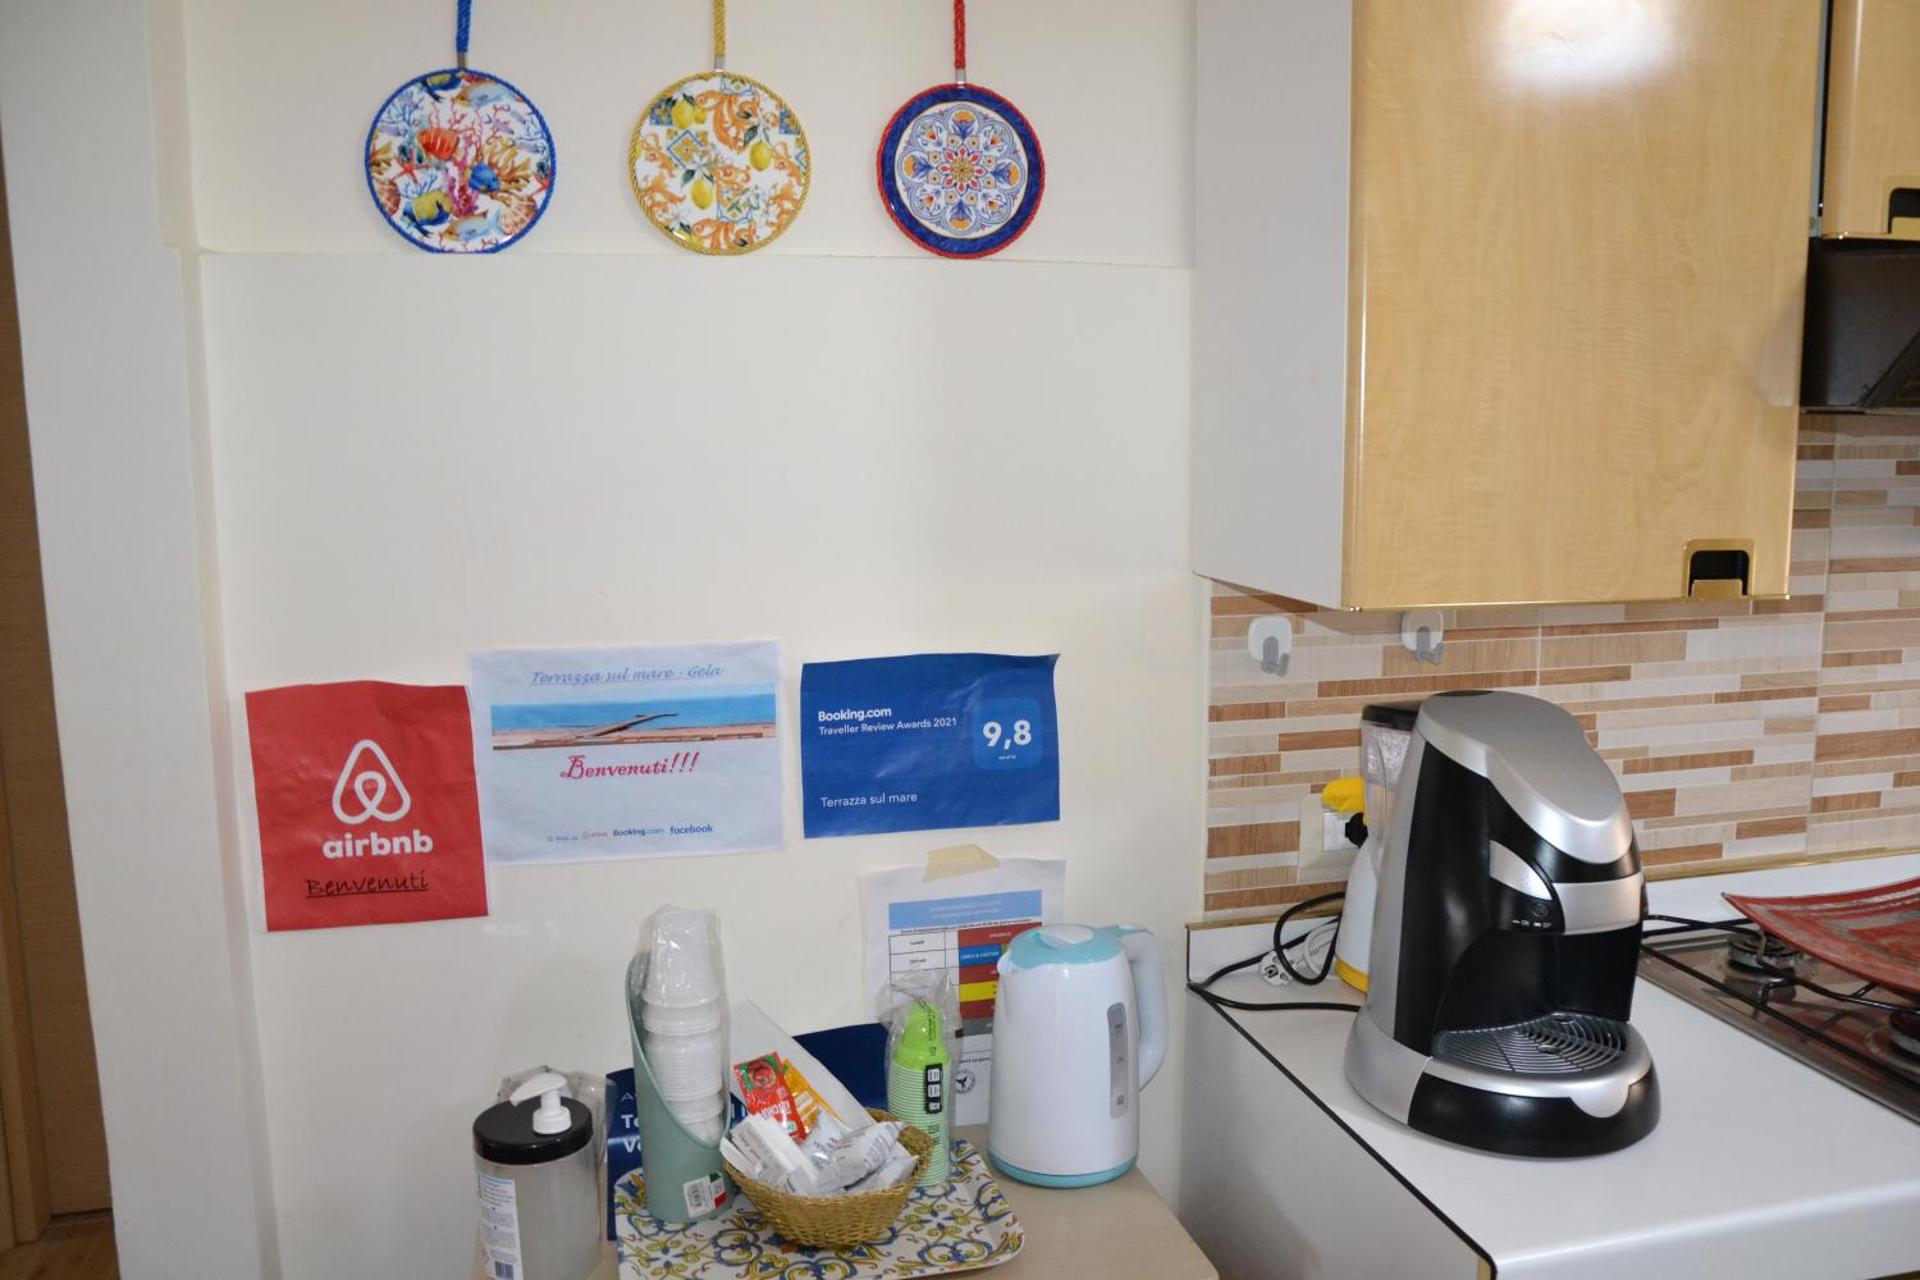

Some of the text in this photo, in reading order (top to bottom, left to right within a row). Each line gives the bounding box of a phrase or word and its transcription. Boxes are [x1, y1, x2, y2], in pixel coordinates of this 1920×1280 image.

[531, 671, 601, 686] Terrazza
[604, 667, 629, 684] sul
[631, 668, 674, 682] mare
[687, 663, 722, 679] Gela
[818, 707, 892, 722] Booking.com
[820, 717, 957, 736] Traveller Review Awards 2021
[982, 719, 1032, 750] 9,8
[560, 751, 701, 780] Benvenuti!!!
[821, 792, 918, 808] Terrazza sul mare
[670, 823, 714, 836] facebook
[322, 829, 433, 859] airbnb
[304, 870, 430, 899] Benvenuti
